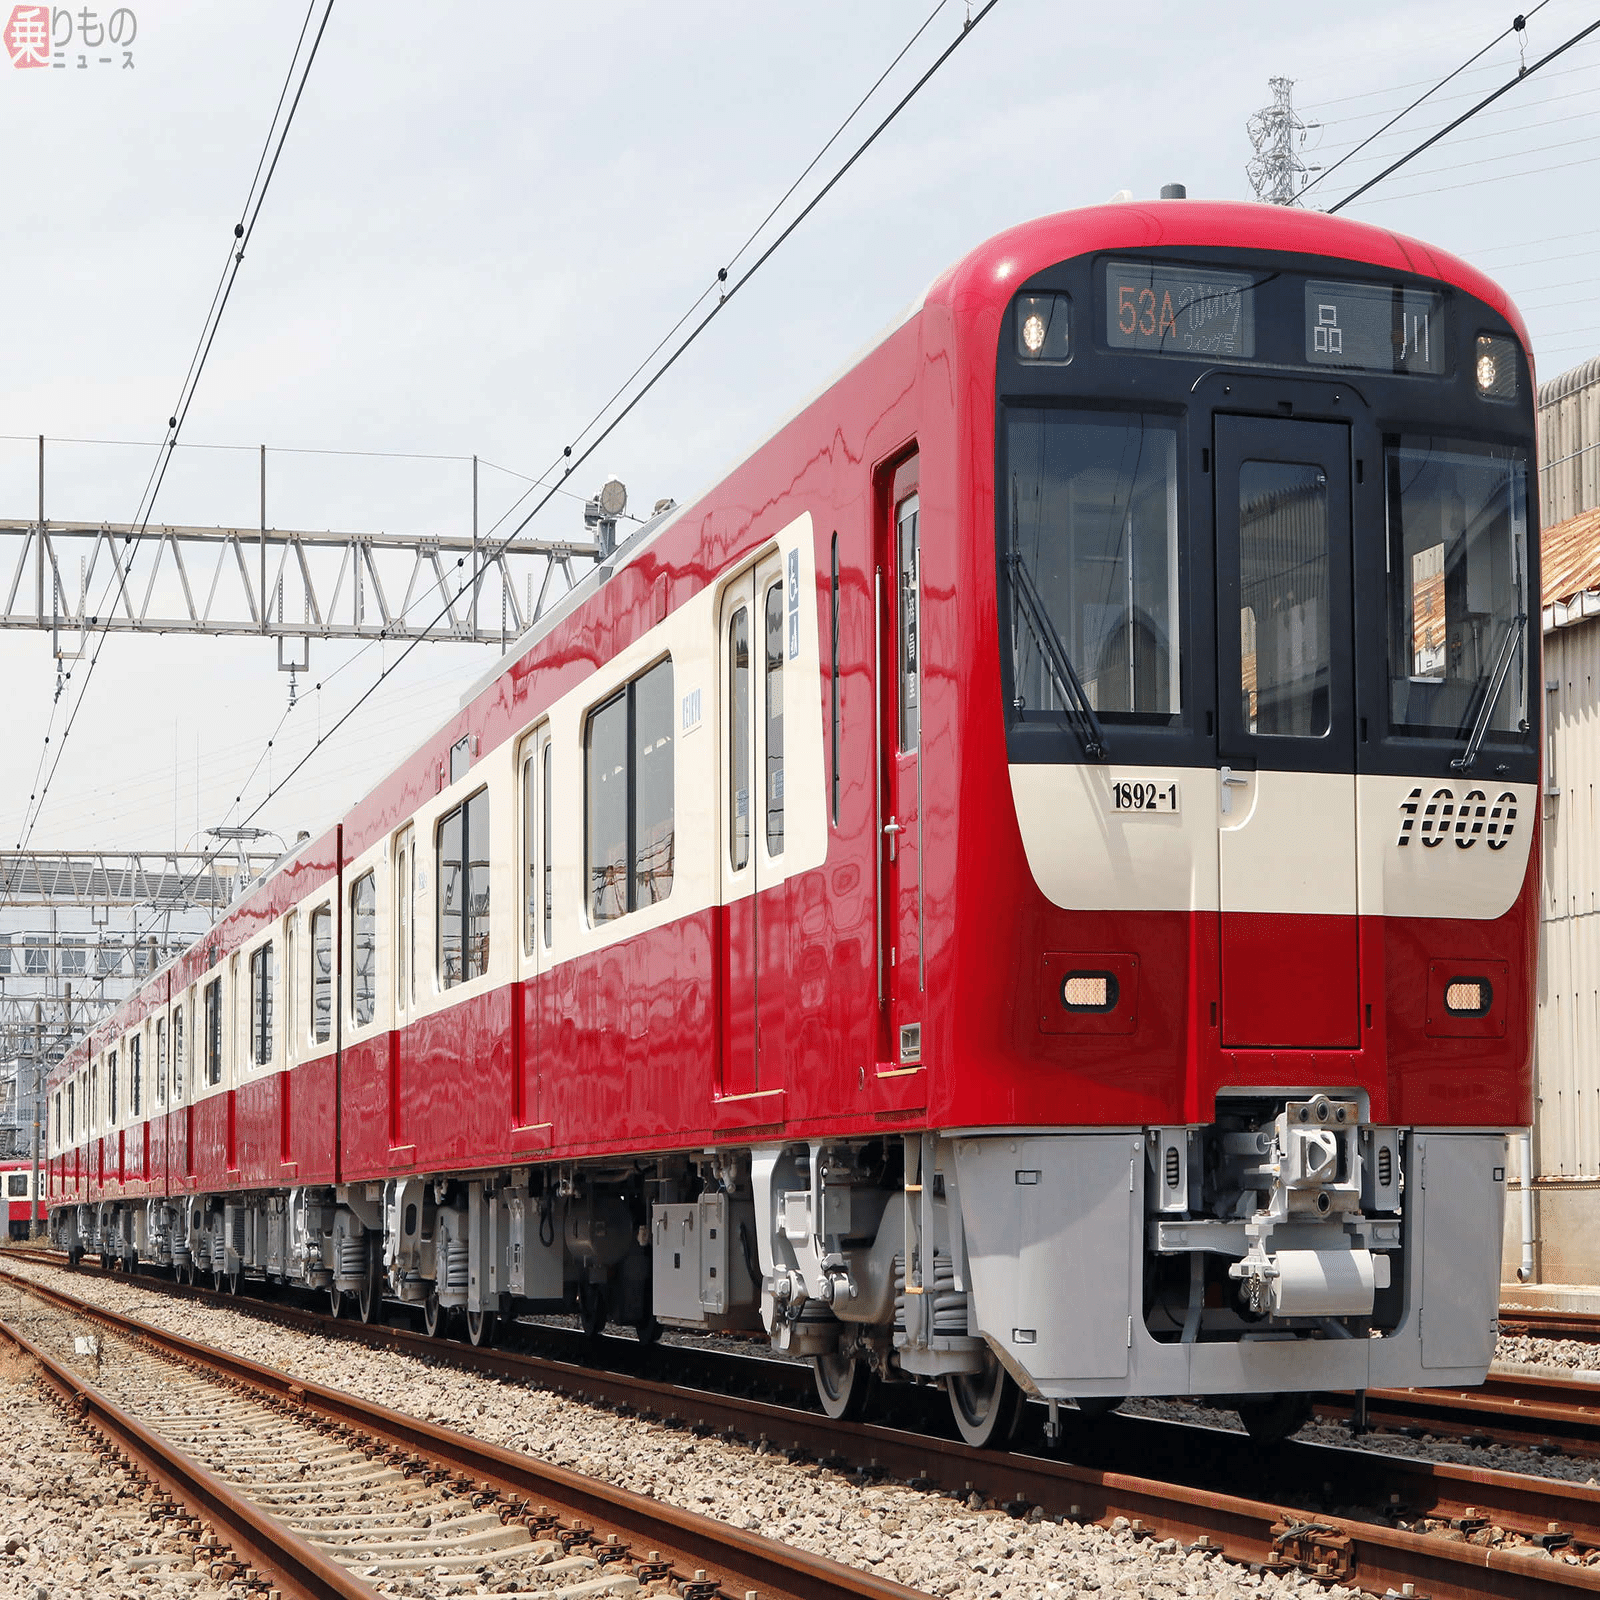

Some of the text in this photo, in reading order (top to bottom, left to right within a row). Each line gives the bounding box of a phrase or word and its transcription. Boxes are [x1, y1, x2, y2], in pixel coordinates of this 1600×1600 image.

[1119, 286, 1176, 337] 53A
[1313, 304, 1429, 362] 品川
[1112, 782, 1176, 810] 1892-1
[1397, 788, 1517, 850] 1000
